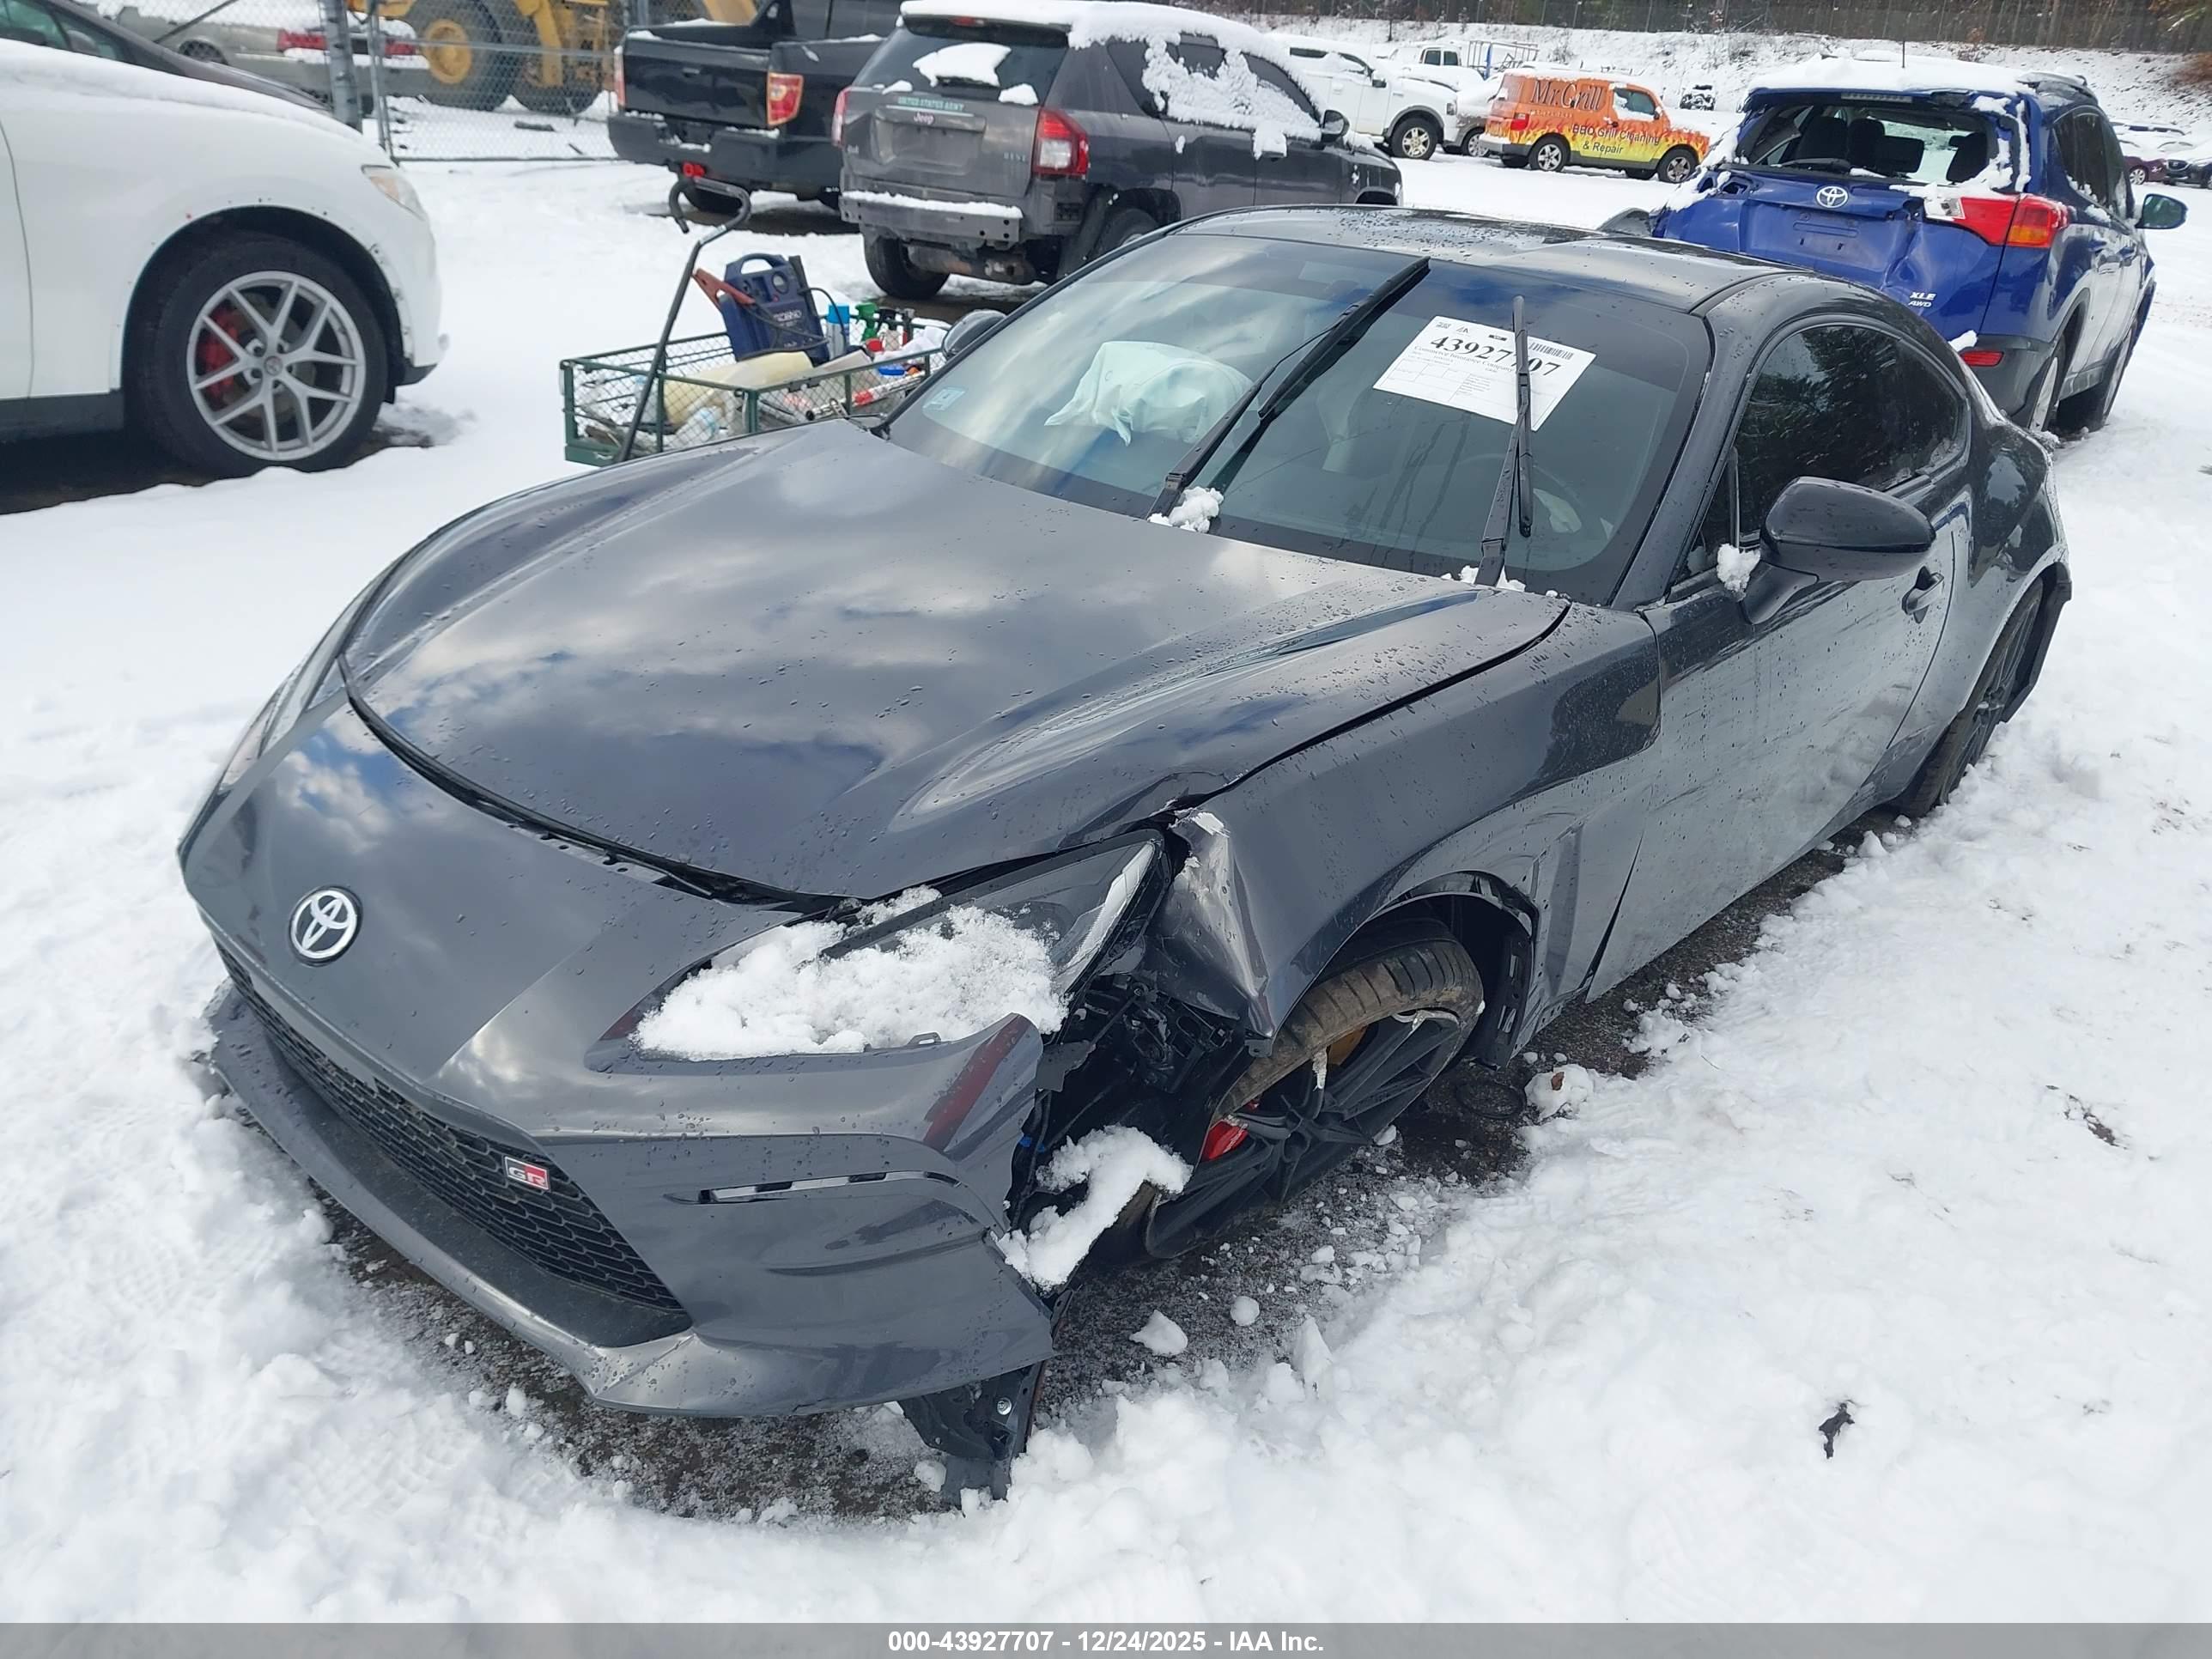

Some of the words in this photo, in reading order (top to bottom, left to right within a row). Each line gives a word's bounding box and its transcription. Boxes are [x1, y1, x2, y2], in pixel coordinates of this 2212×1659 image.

[1561, 82, 1603, 111] Grill
[913, 112, 933, 125] Jeep
[1597, 126, 1618, 139] Grill
[1620, 130, 1660, 147] Cleaning
[1583, 140, 1589, 149] &
[1593, 142, 1623, 155] Repair
[1909, 292, 1937, 301] XLE
[508, 1166, 546, 1187] GR
